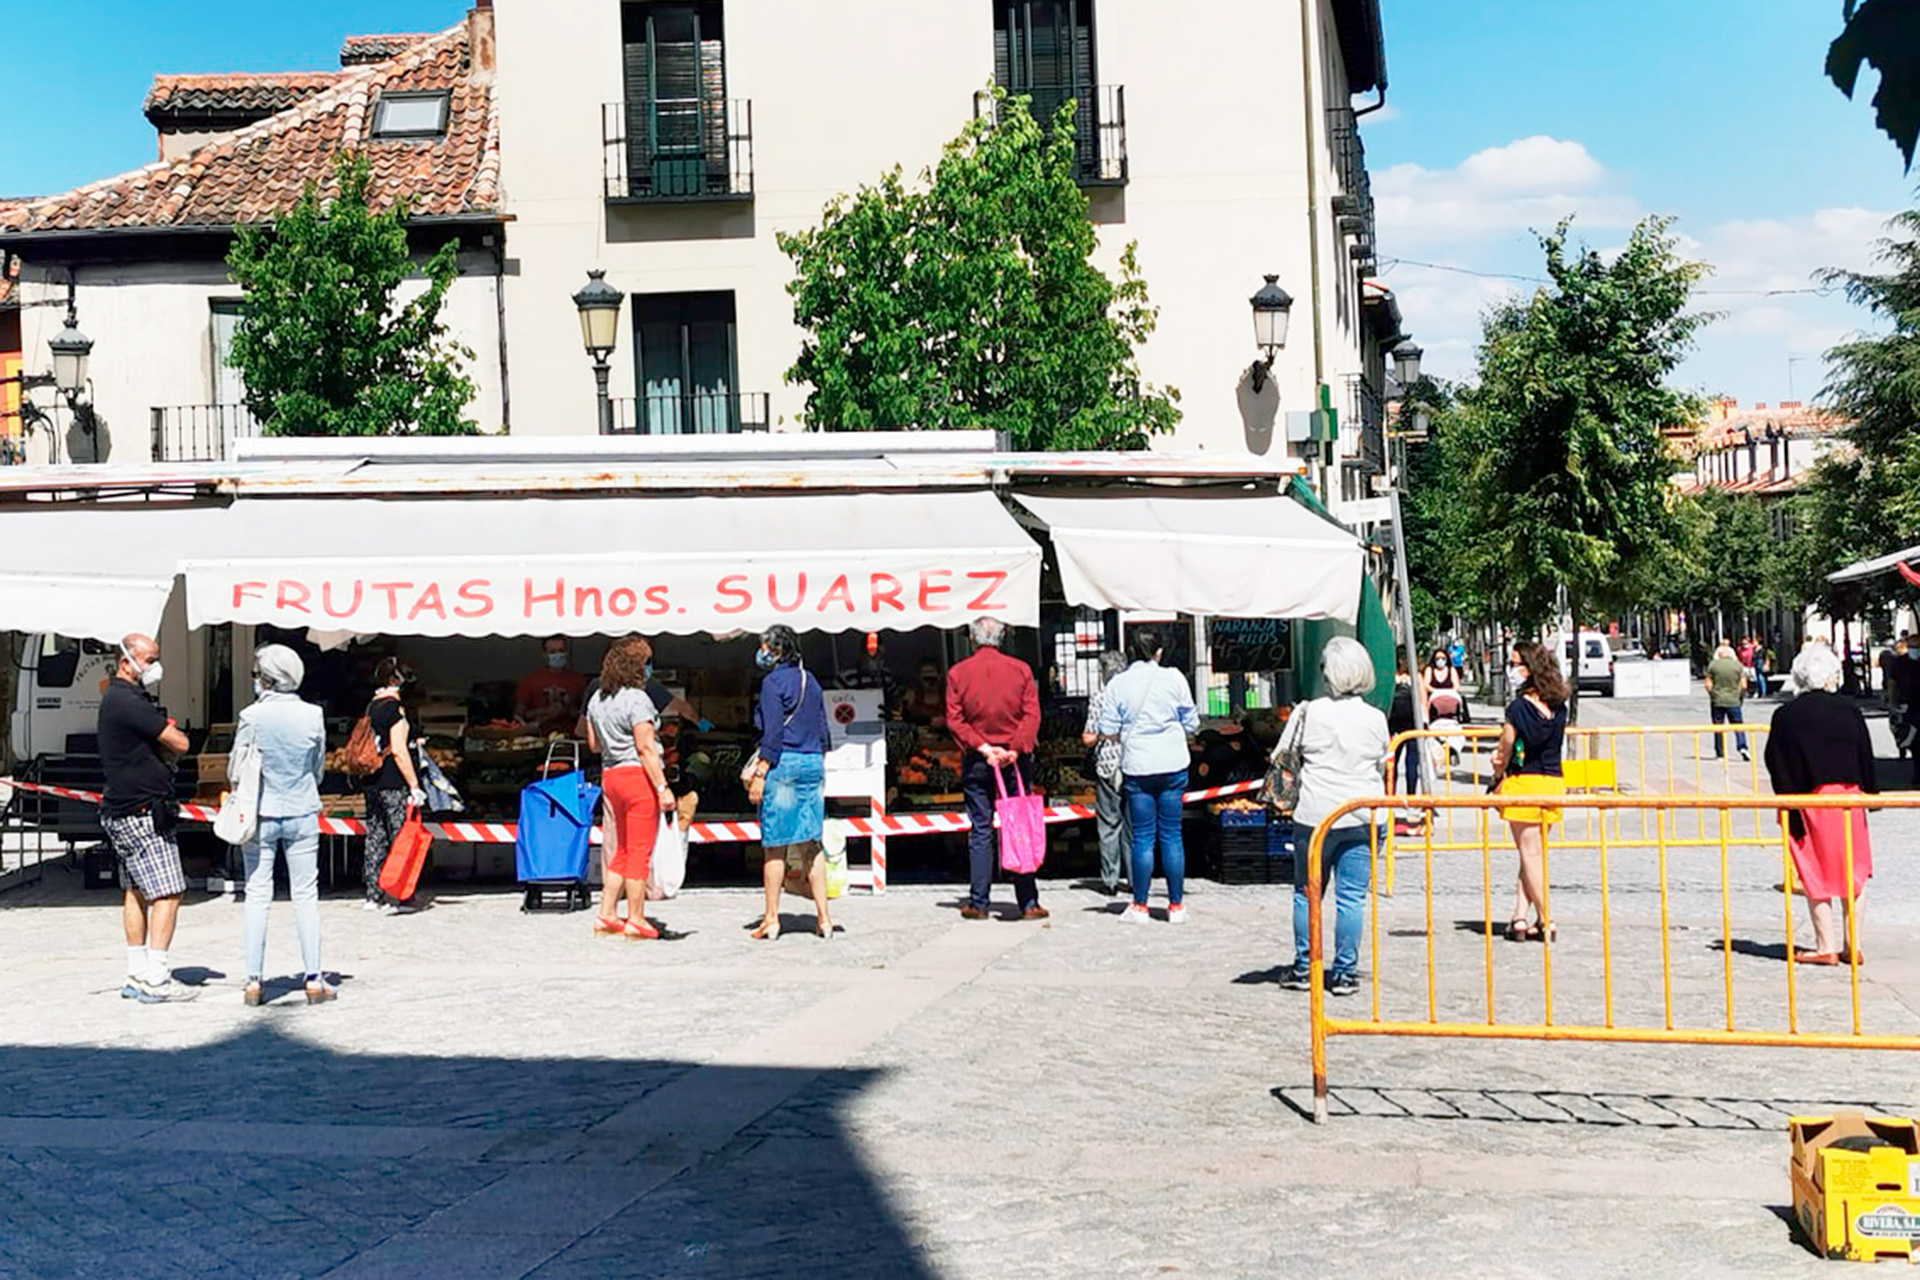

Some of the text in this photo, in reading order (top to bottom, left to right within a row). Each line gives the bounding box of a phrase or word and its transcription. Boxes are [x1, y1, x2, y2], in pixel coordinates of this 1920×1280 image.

[232, 569, 1008, 620] FRUTAS Hnos. SUAREZ
[1213, 618, 1290, 633] NARANJAS
